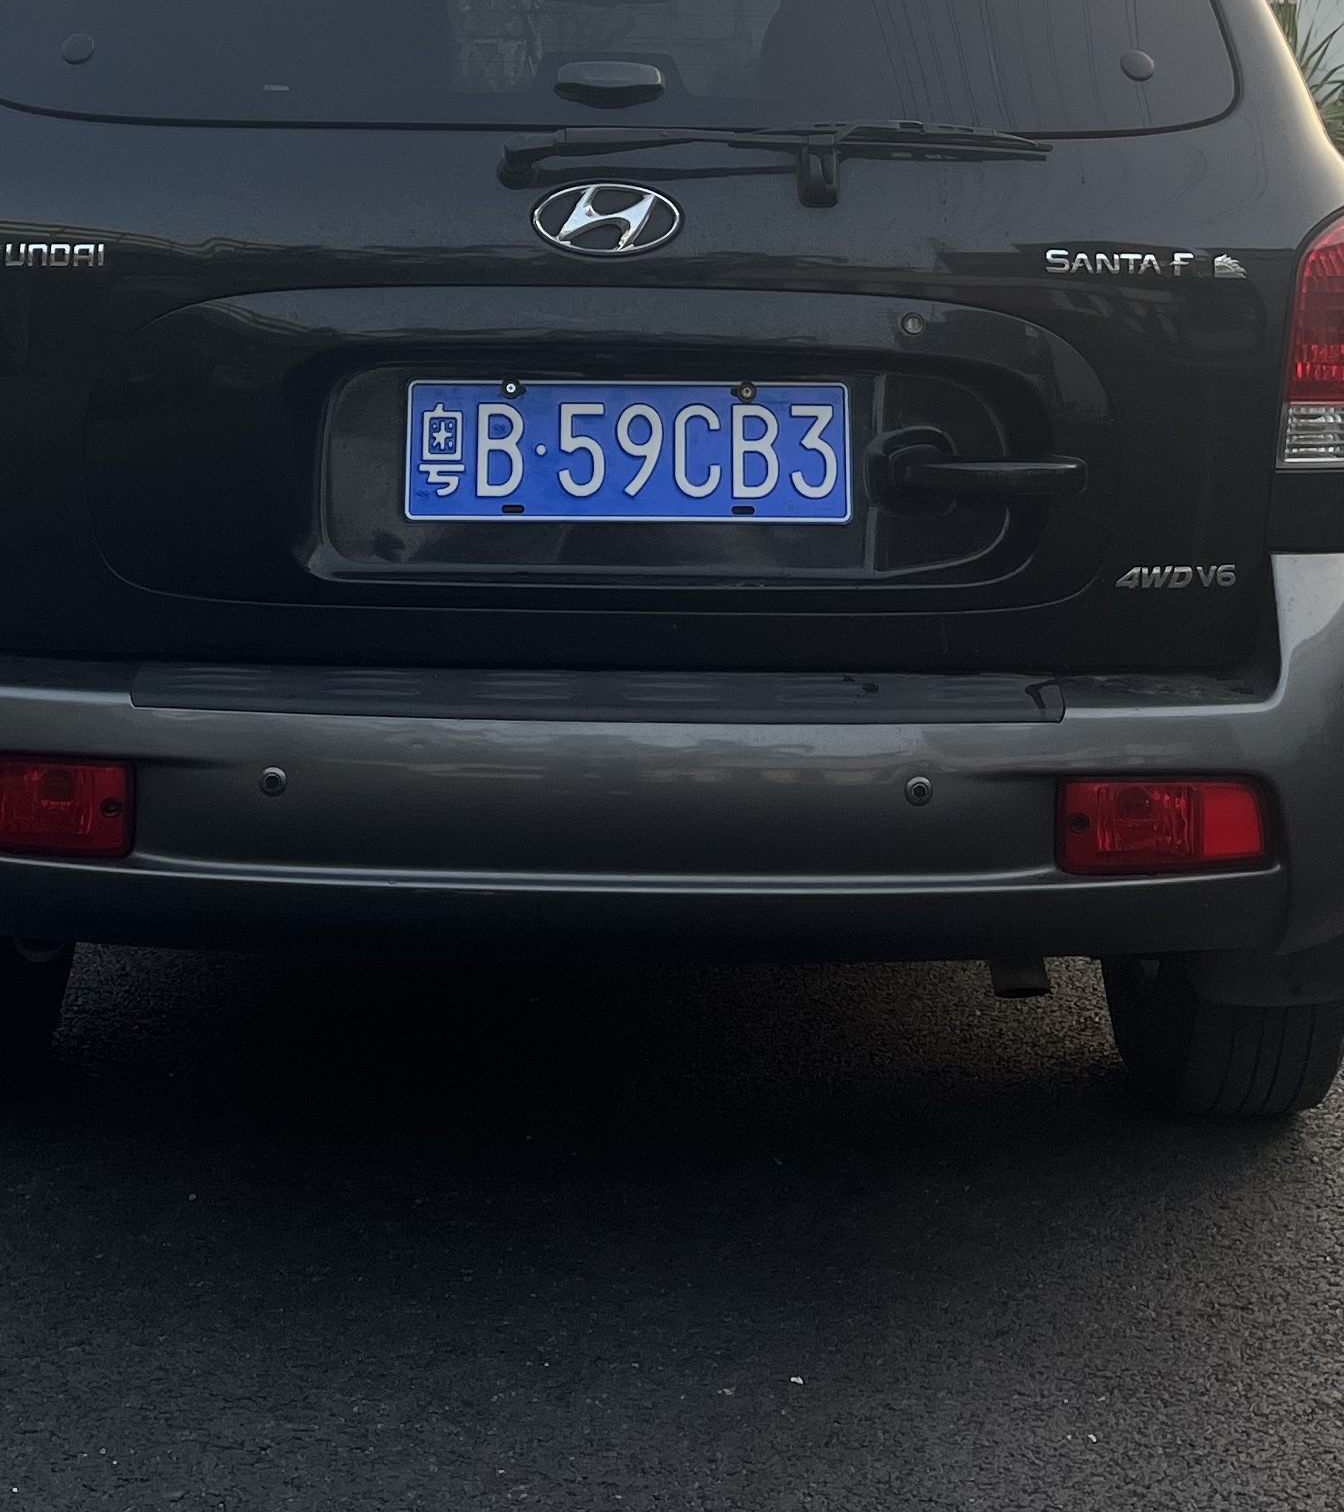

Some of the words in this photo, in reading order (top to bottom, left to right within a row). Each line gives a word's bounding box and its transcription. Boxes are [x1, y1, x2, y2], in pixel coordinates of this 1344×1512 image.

[1045, 248, 1162, 275] SANTA
[418, 402, 839, 500] 粤B·59CB3
[1115, 565, 1194, 589] 4WD
[1196, 564, 1237, 587] V6
